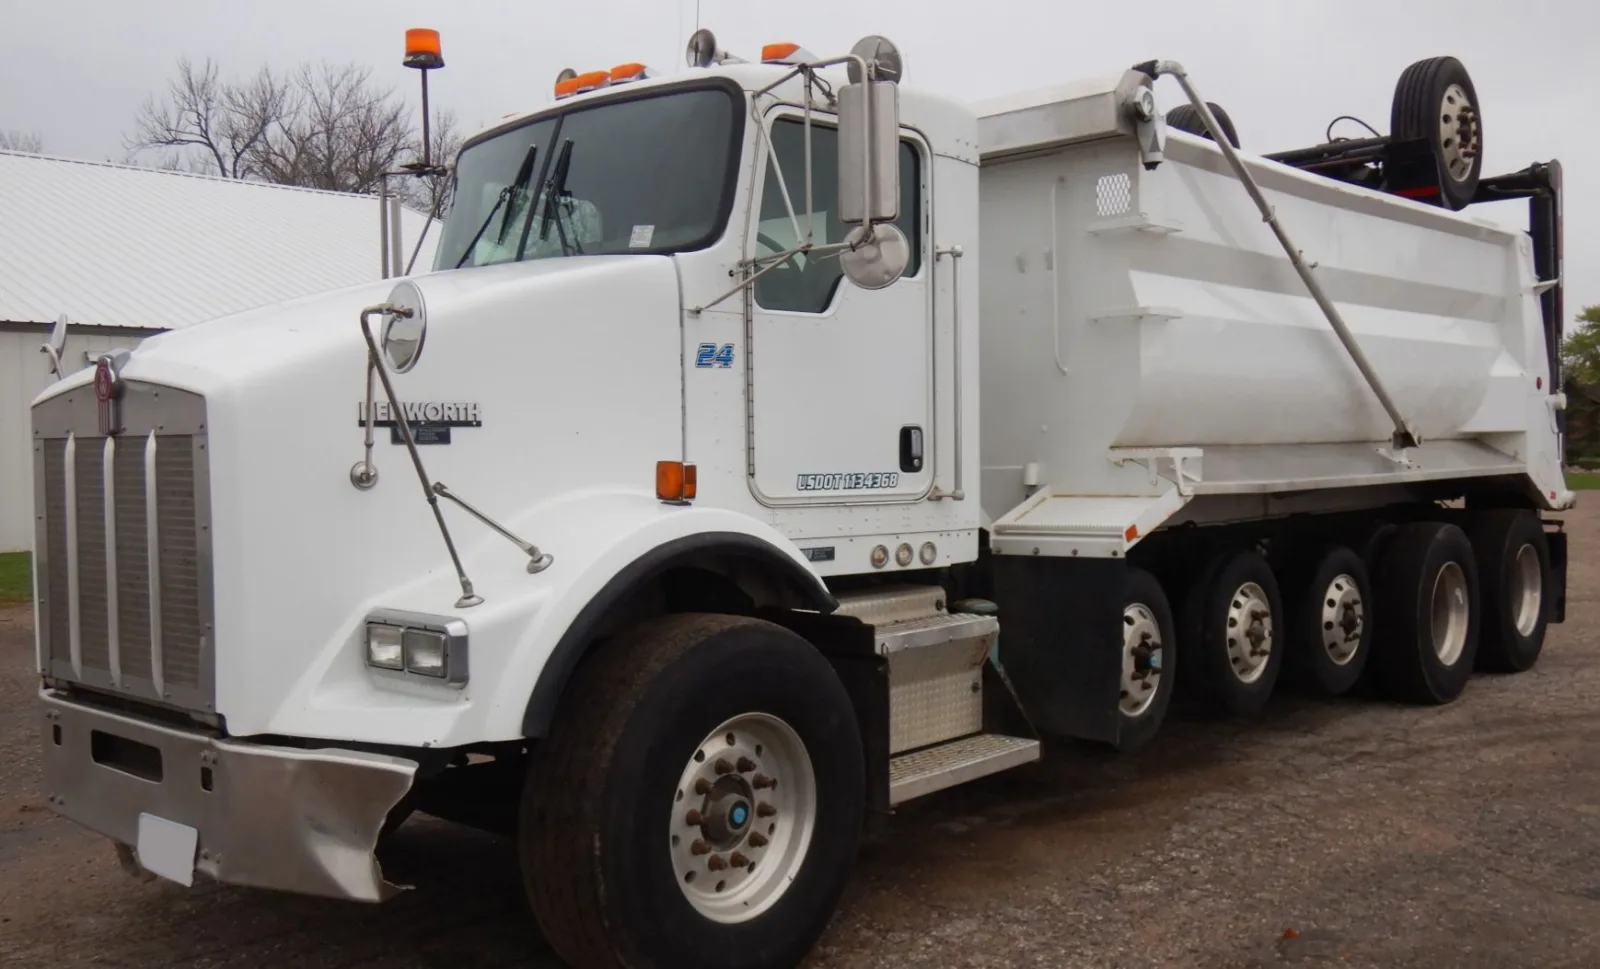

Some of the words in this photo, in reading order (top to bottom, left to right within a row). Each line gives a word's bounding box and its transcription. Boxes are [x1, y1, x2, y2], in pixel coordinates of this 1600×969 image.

[695, 343, 735, 368] 24
[797, 473, 842, 490] USDOT
[843, 472, 899, 489] 1134368
